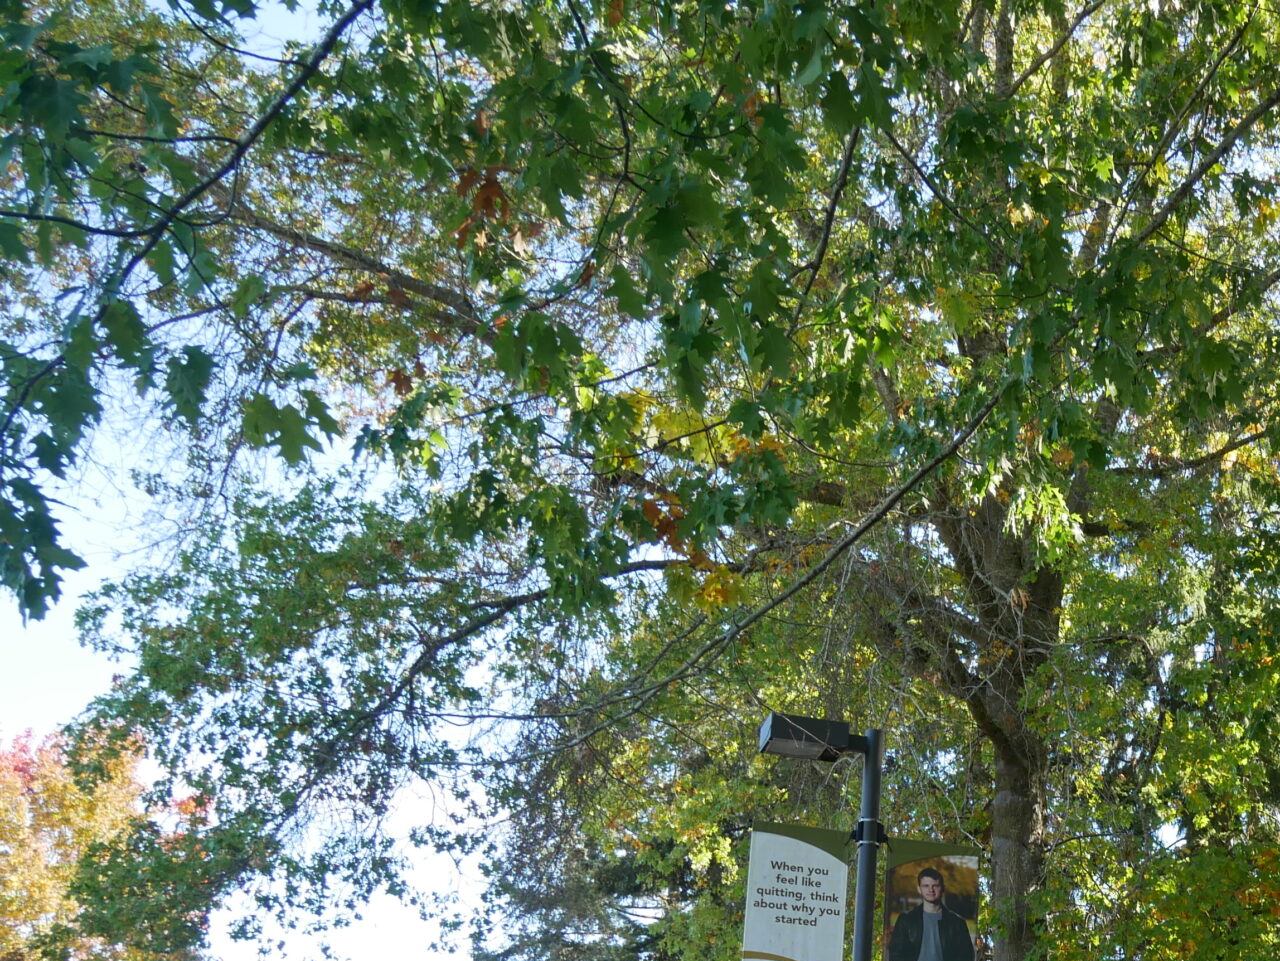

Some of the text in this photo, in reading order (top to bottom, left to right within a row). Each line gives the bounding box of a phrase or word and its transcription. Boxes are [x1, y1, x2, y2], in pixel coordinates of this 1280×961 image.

[770, 860, 829, 876] When you
[776, 873, 822, 888] feel like
[756, 886, 839, 903] quitting, think
[753, 898, 840, 917] about why you
[775, 915, 817, 927] started
